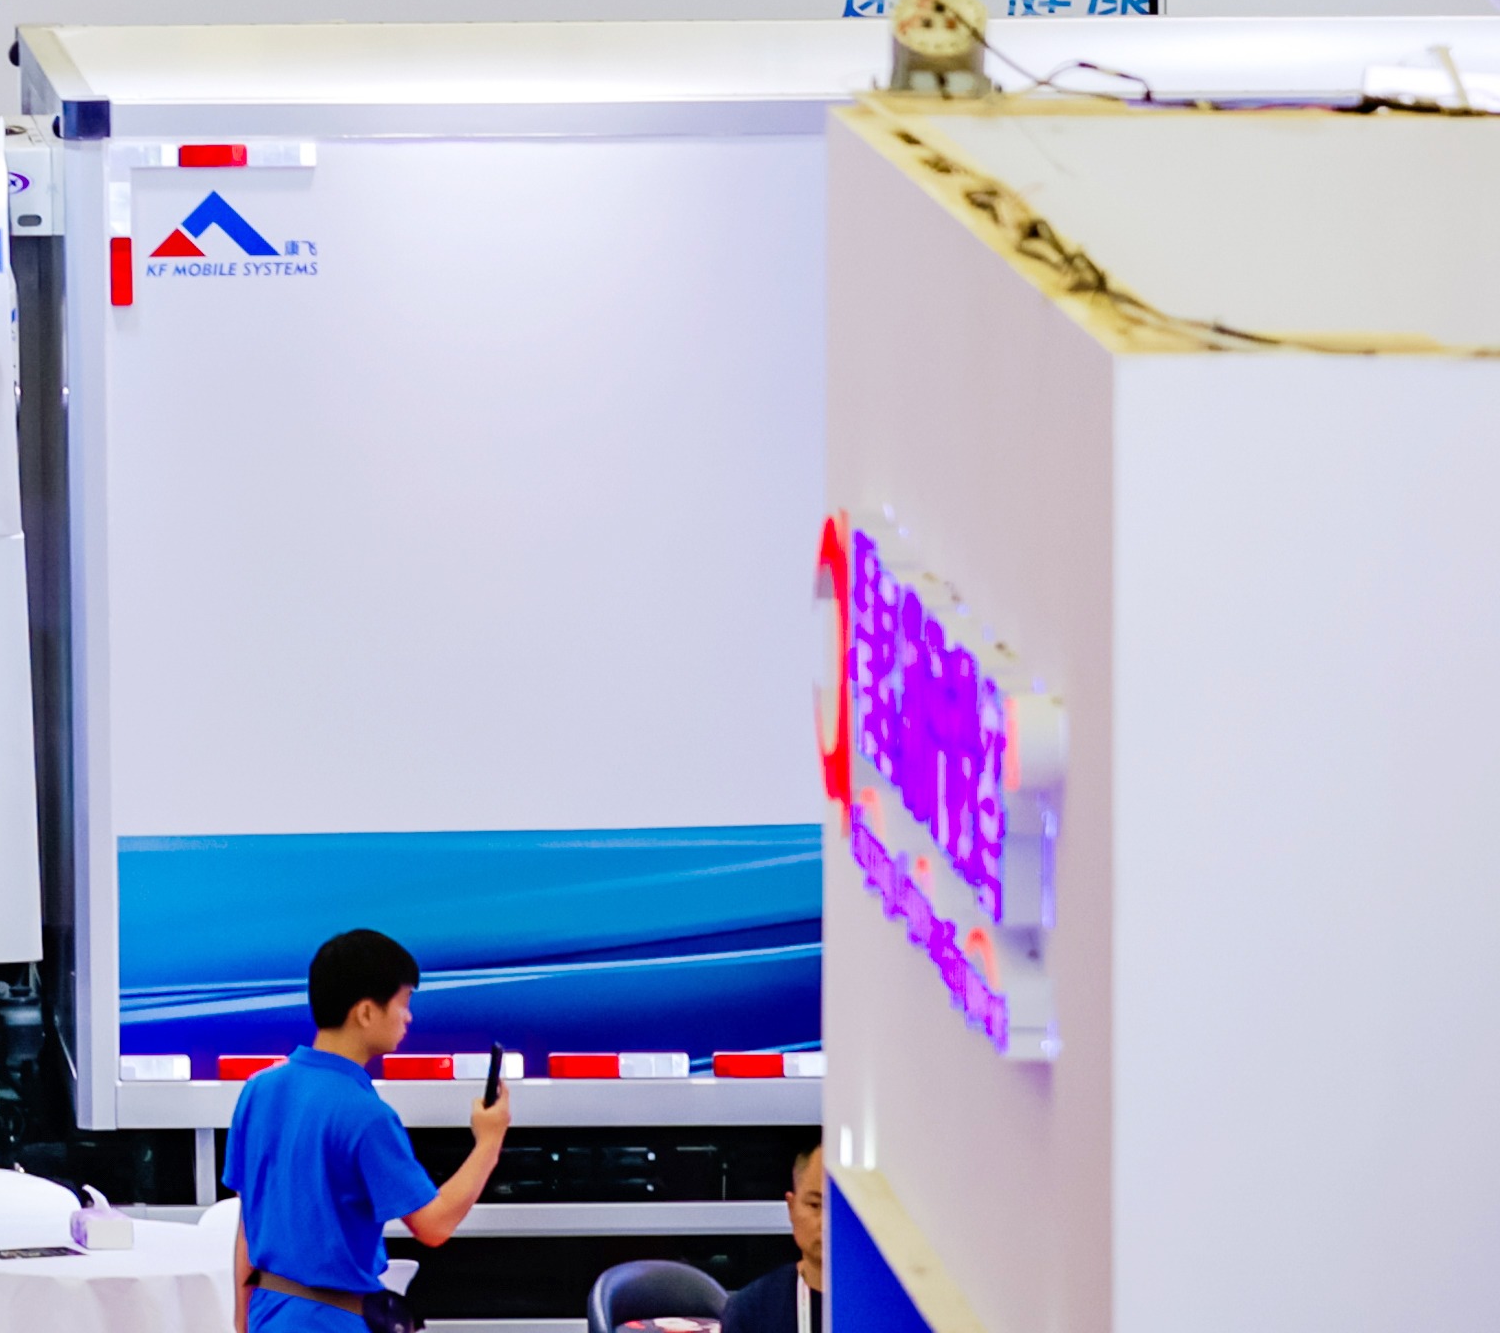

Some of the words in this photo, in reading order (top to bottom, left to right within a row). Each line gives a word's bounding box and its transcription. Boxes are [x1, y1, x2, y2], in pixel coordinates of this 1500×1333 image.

[284, 240, 319, 257] 康飞
[146, 261, 168, 278] KF
[172, 261, 237, 277] MOBILE
[243, 261, 319, 277] SYSTEMS
